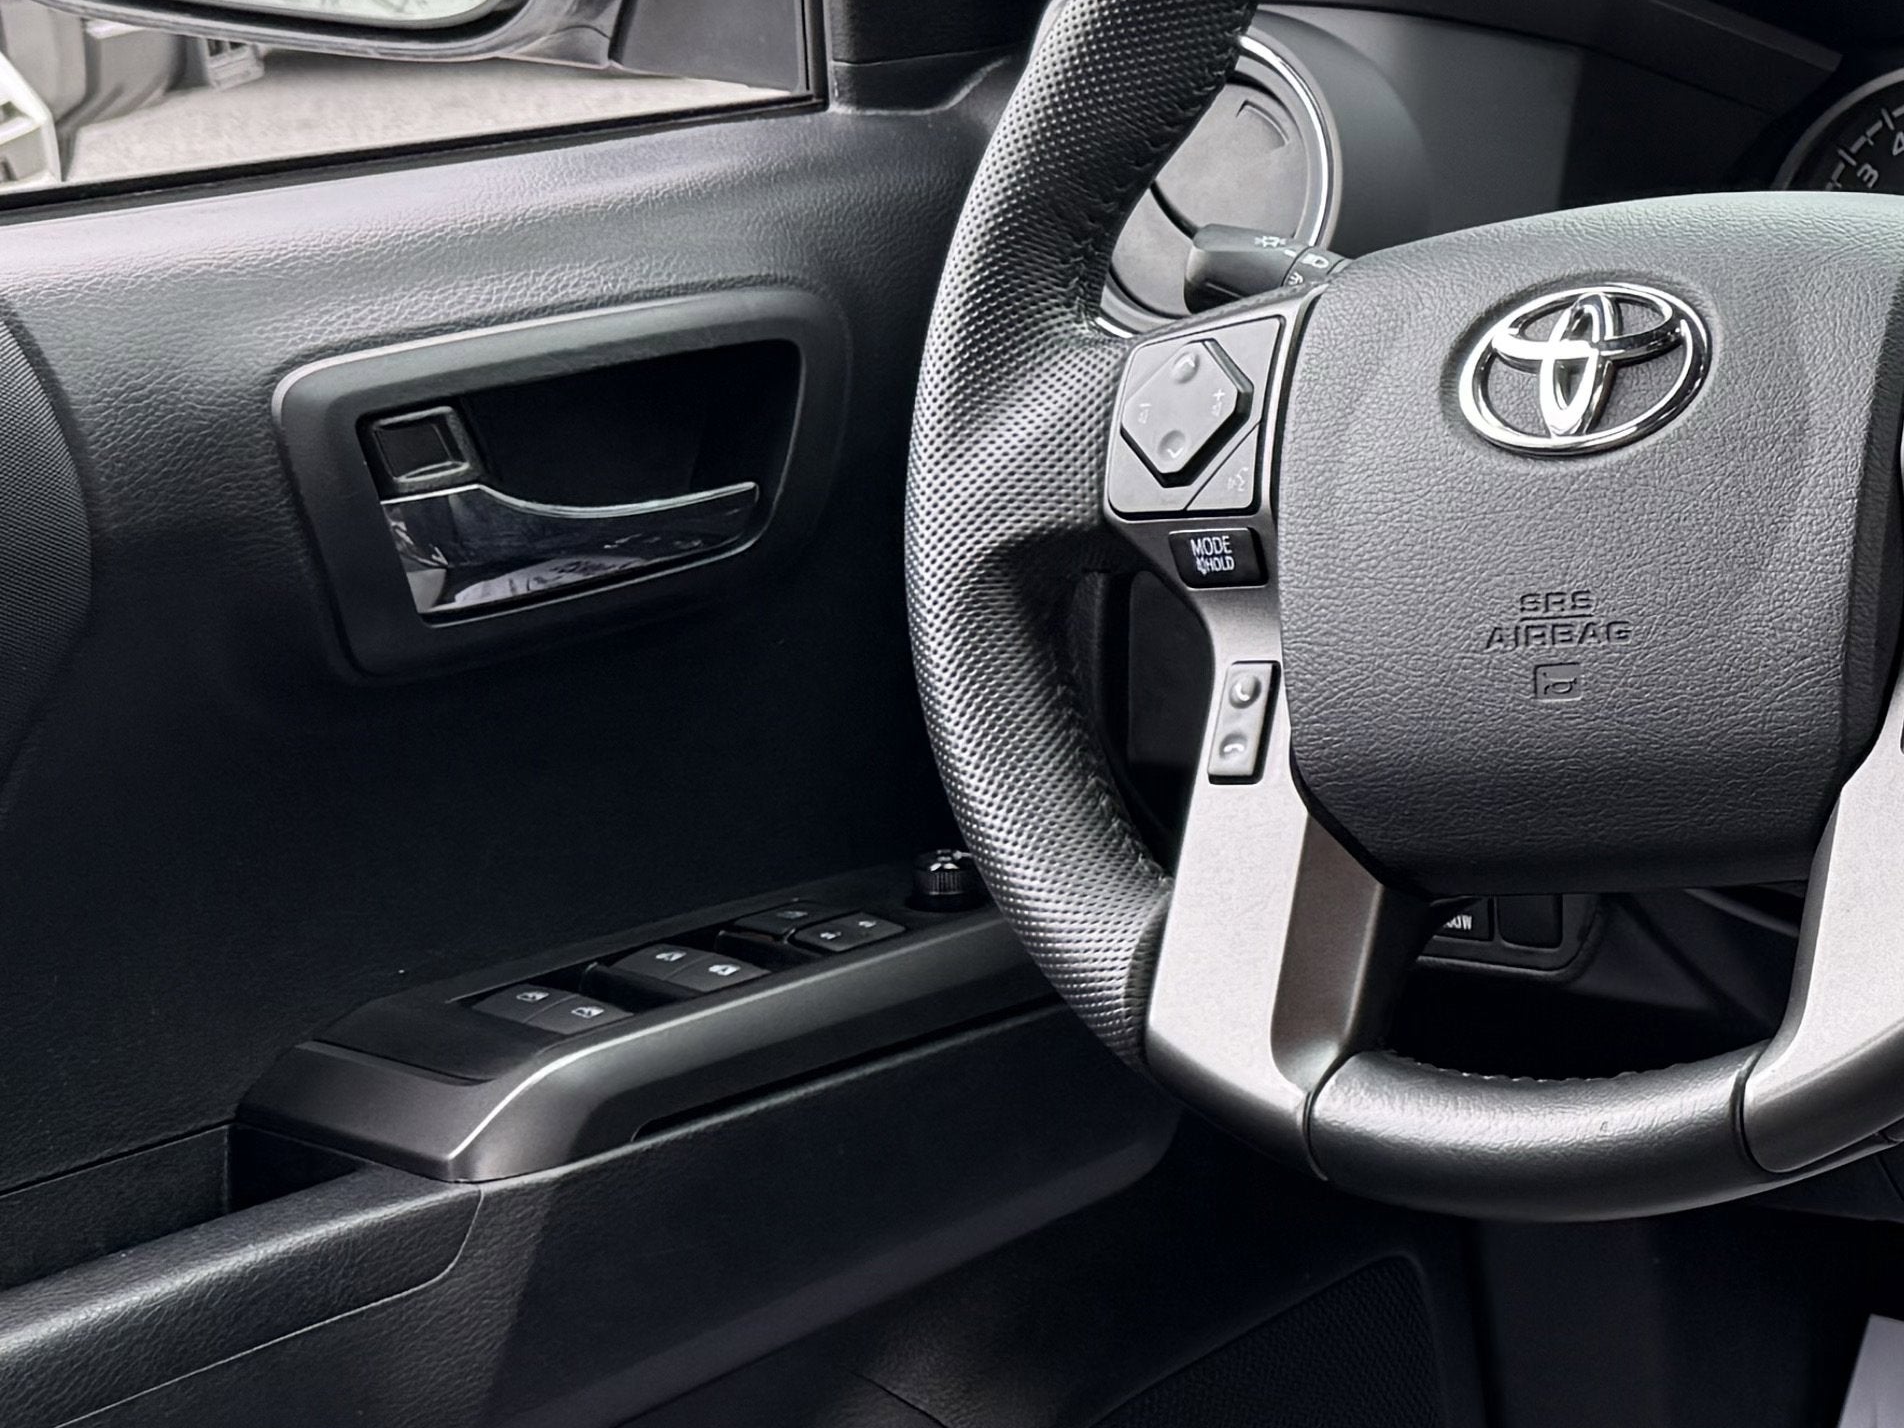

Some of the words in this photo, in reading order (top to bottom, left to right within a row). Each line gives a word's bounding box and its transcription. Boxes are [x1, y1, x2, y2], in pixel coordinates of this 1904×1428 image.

[1856, 162, 1879, 189] 3
[1190, 535, 1232, 556] MODE
[1519, 590, 1594, 613] SRS
[1484, 622, 1633, 652] AIRBAG
